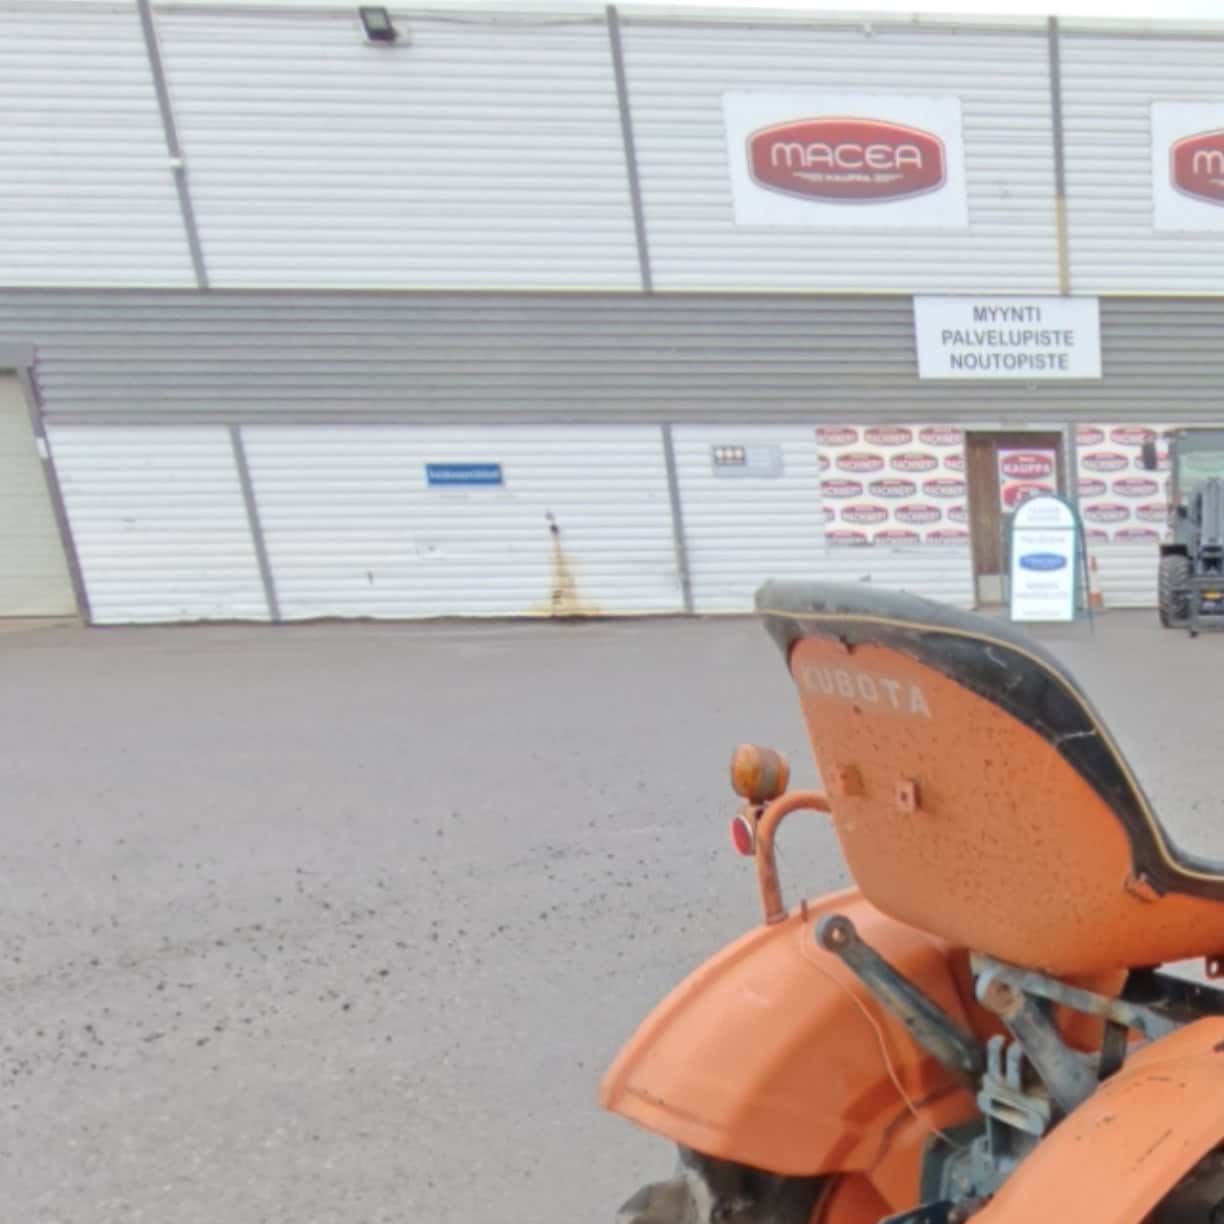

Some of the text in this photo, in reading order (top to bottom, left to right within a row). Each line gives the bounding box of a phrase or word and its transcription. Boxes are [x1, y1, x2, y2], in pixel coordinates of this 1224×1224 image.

[770, 142, 923, 169] MACEA
[972, 306, 1042, 323] MYYNTI
[941, 329, 1075, 347] PALVELUPISTE
[949, 352, 1071, 371] NOUTOPISTE
